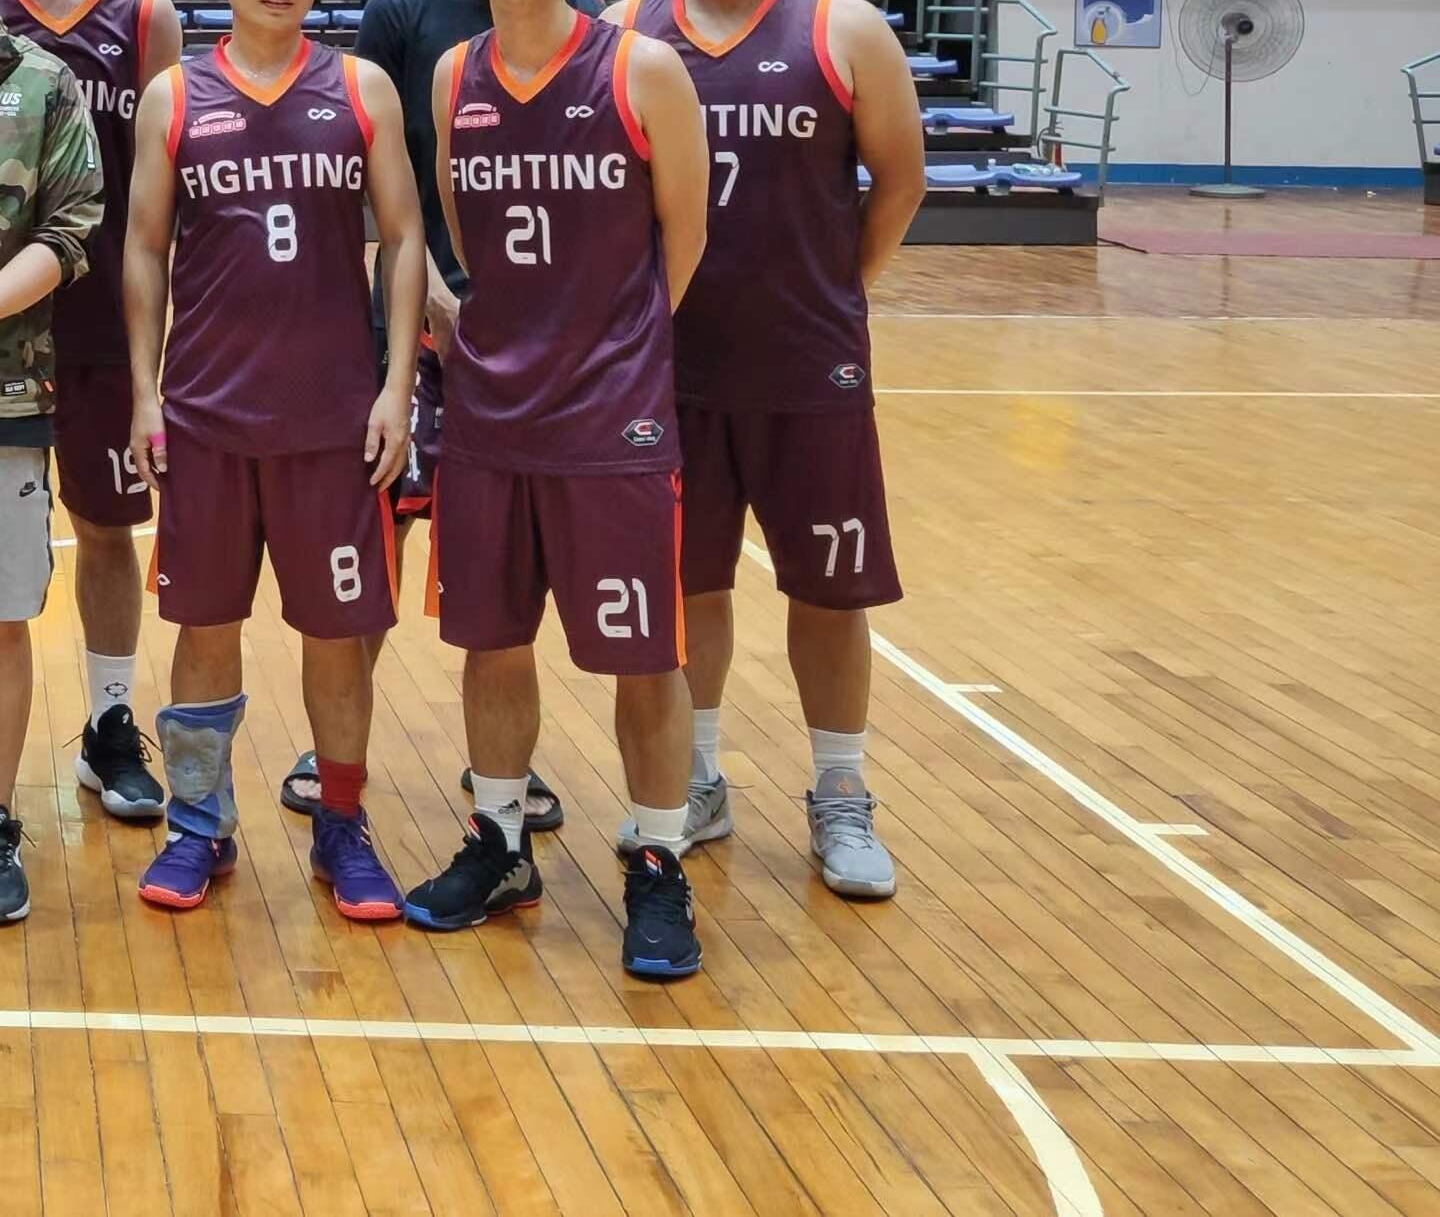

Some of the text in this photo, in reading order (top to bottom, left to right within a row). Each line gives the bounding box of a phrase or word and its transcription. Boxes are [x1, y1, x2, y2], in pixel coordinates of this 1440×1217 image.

[179, 153, 363, 199] FIGHTING
[714, 151, 741, 207] 7
[265, 203, 298, 263] 8
[504, 204, 552, 266] 21
[329, 544, 362, 604] 8
[811, 516, 868, 578] 77
[595, 577, 651, 640] 21
